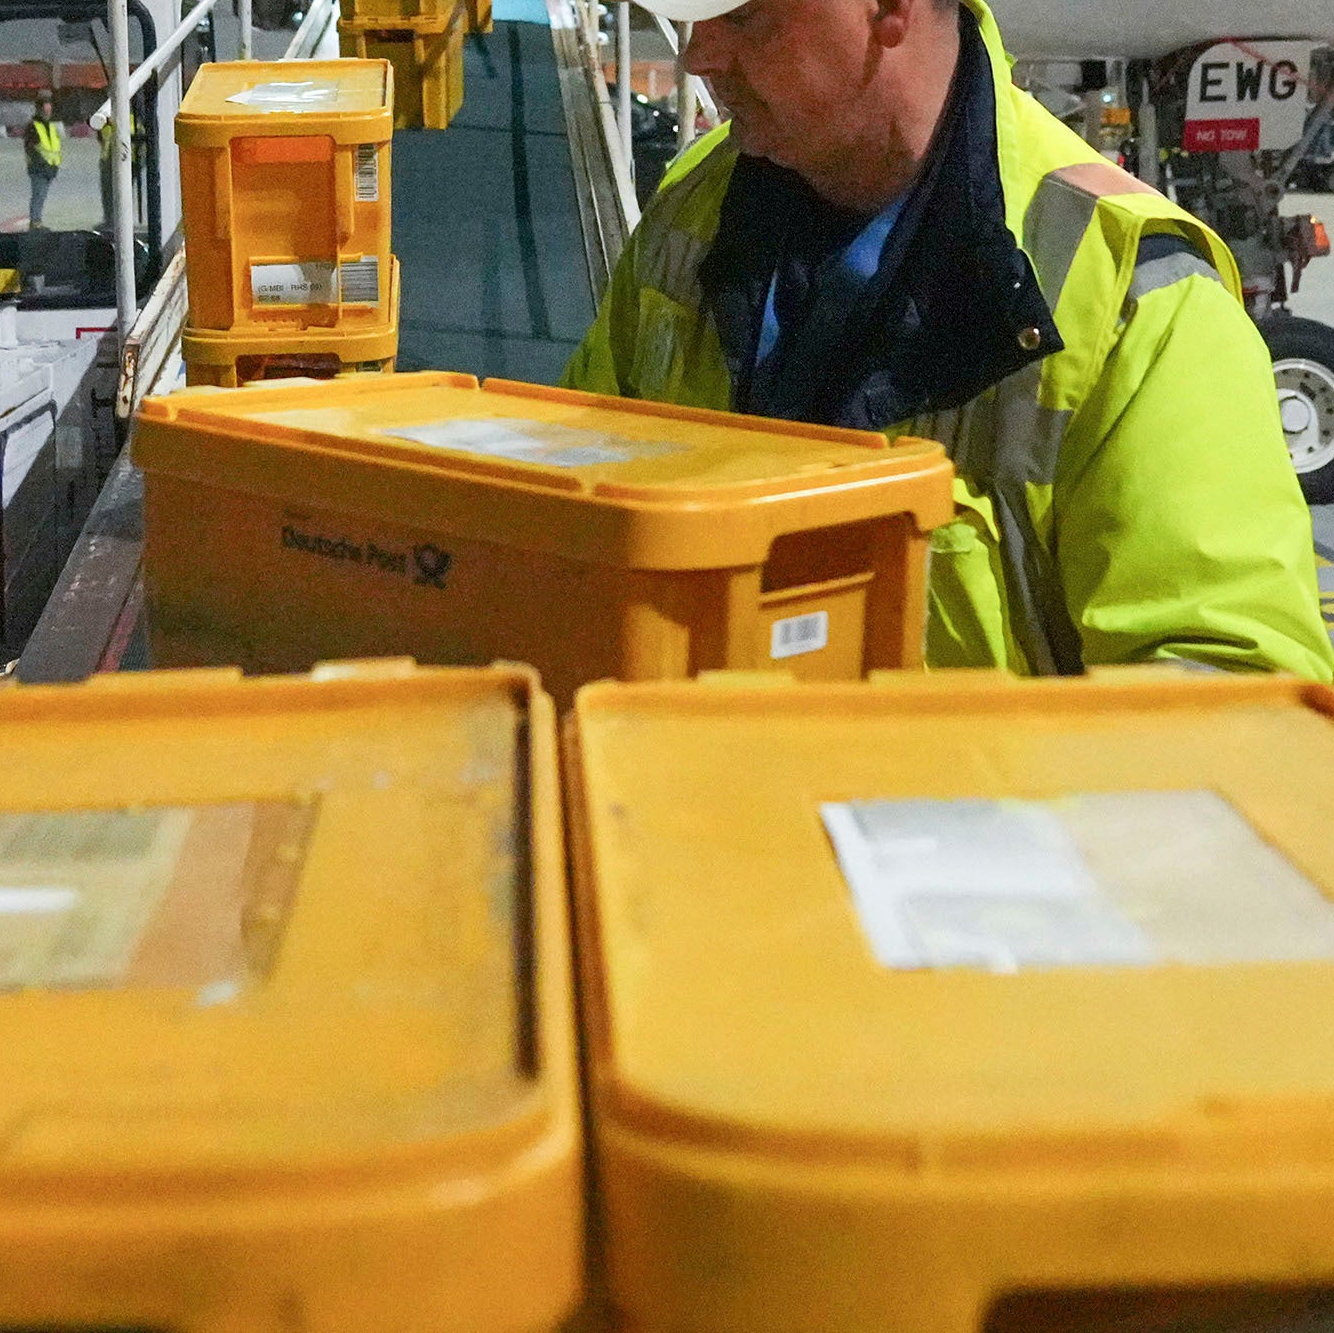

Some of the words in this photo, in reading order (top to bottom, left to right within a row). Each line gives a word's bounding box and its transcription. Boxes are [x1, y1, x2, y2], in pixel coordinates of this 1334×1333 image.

[1199, 60, 1298, 102] EWG
[282, 525, 362, 561] Deutsche
[366, 542, 407, 574] Post
